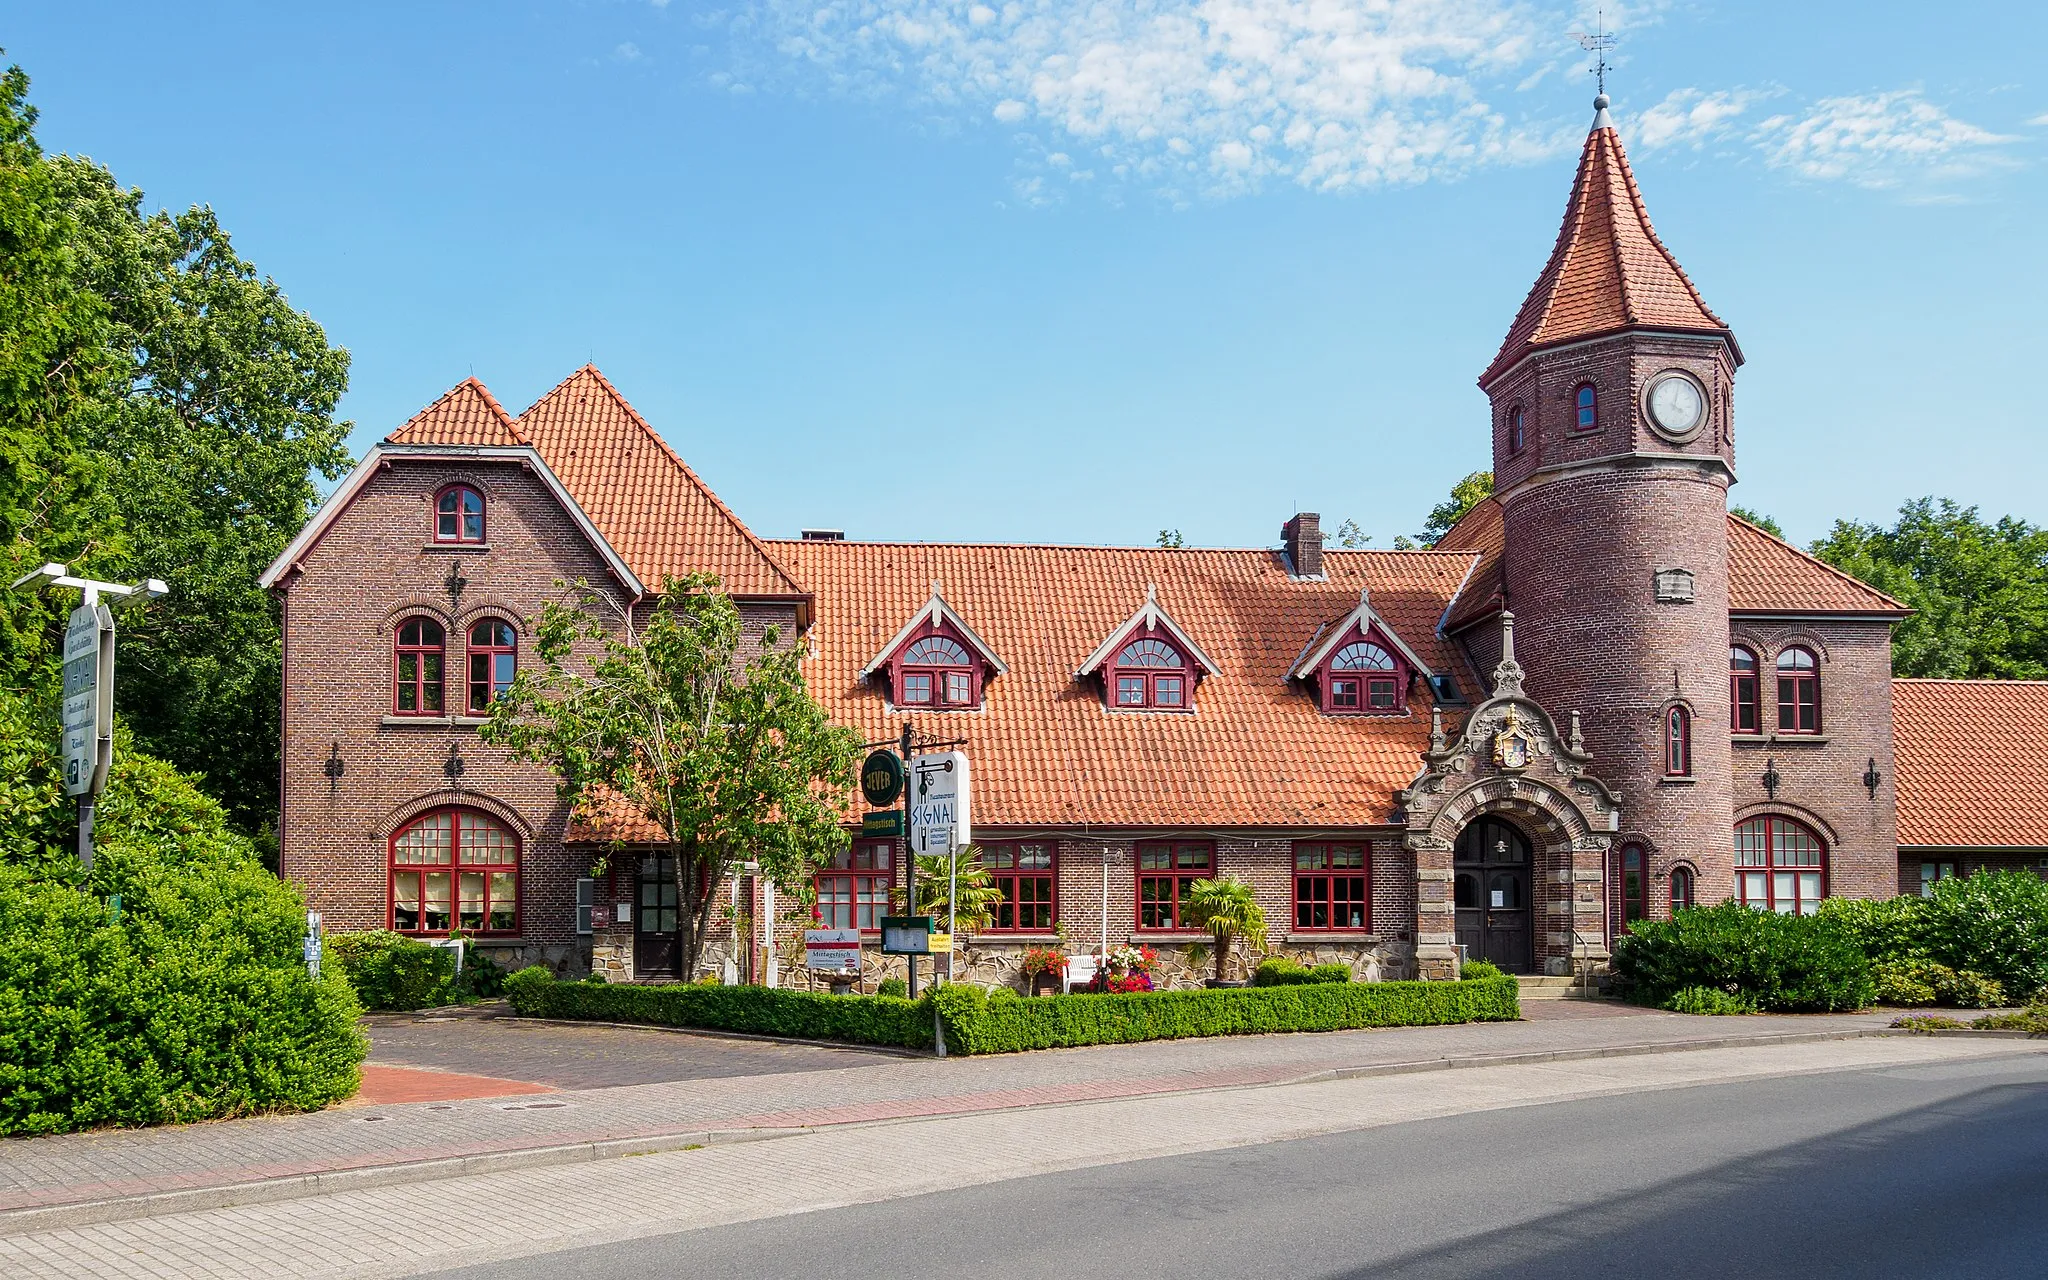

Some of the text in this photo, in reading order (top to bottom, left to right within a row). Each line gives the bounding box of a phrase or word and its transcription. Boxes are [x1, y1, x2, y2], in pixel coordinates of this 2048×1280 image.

[867, 771, 891, 791] JEVER
[912, 803, 957, 826] SIGNAL
[812, 951, 851, 959] Mittagstisch
